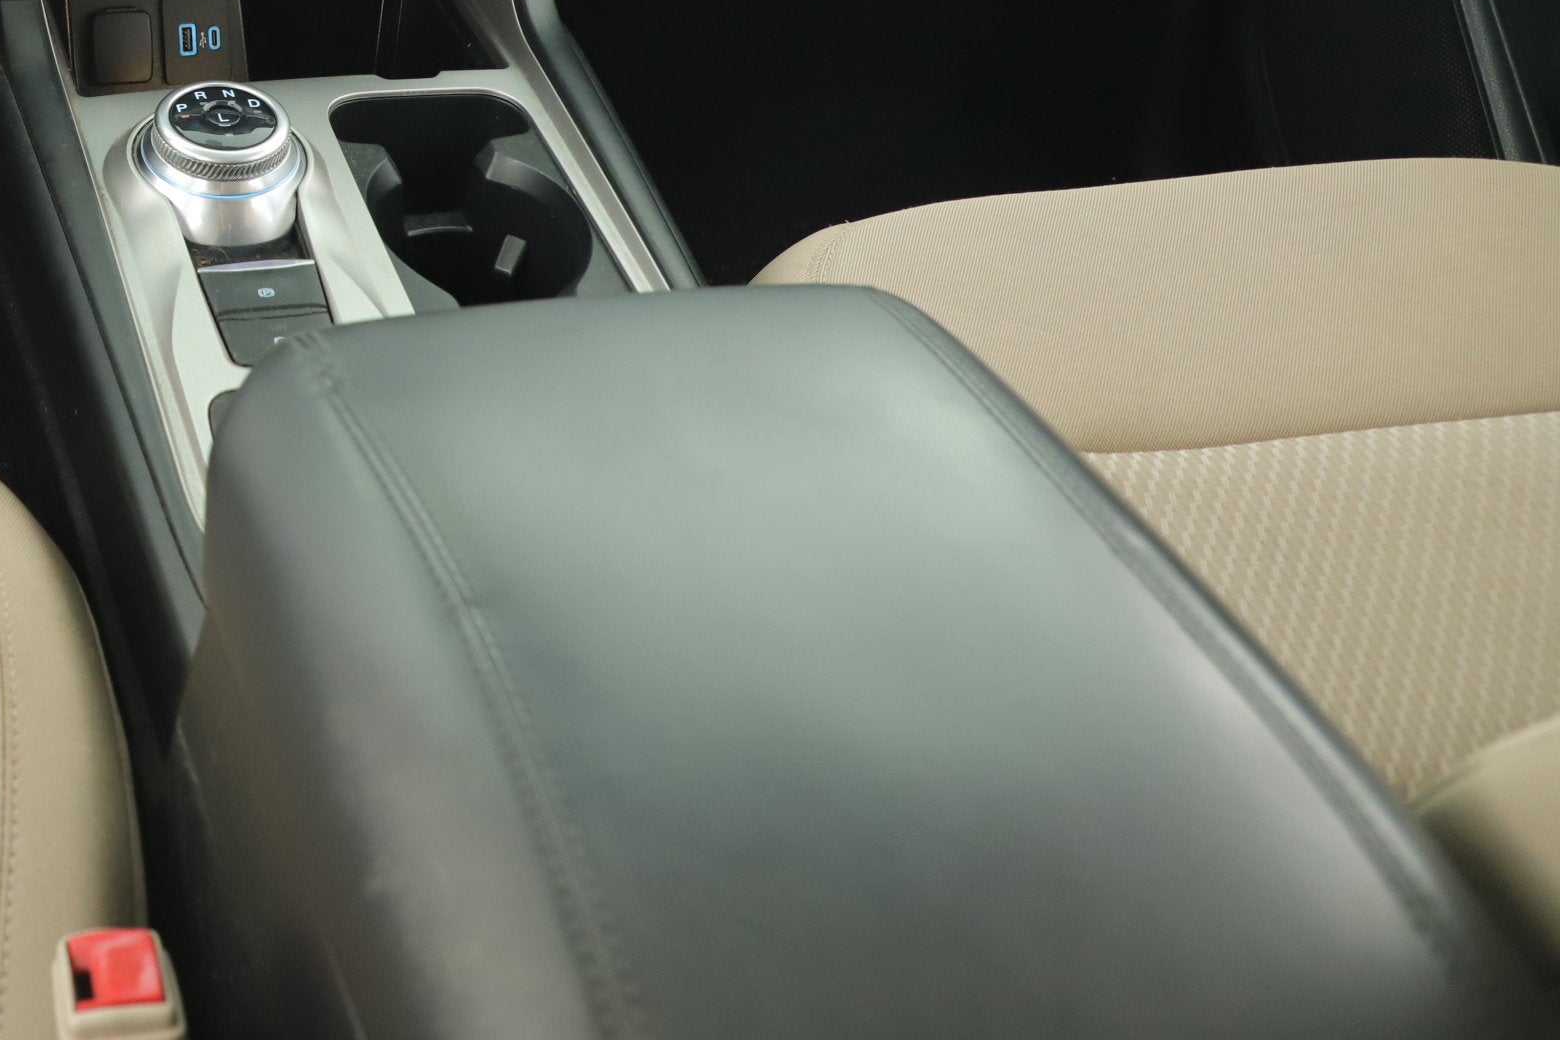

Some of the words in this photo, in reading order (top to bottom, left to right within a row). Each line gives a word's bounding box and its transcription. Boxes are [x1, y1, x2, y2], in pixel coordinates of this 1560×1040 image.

[194, 91, 207, 100] R
[222, 89, 236, 98] N
[176, 103, 187, 112] P
[247, 99, 261, 108] D
[218, 113, 229, 122] L
